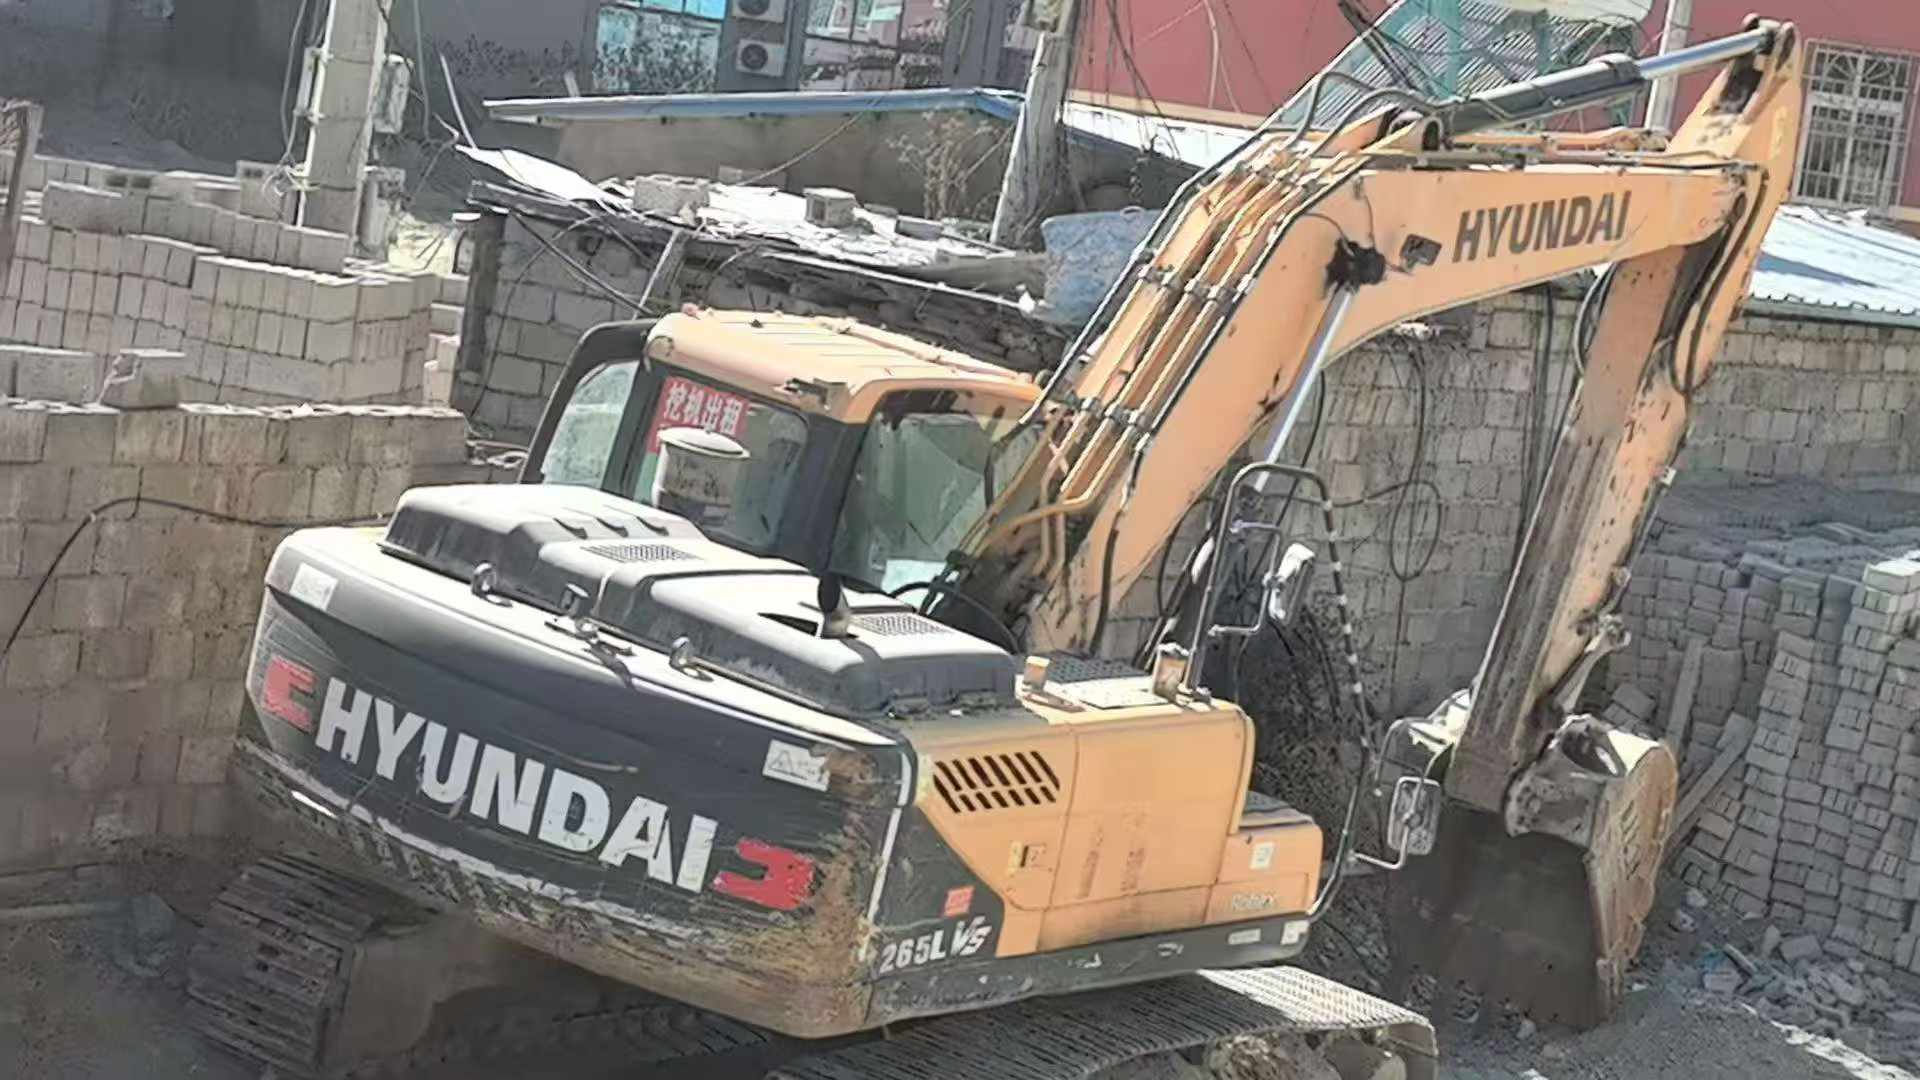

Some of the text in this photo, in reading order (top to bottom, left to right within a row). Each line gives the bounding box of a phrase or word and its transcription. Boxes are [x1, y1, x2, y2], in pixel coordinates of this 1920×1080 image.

[1453, 190, 1631, 263] HYUNDAI
[664, 382, 743, 434] 挖机出租
[315, 677, 718, 892] HYUNDAI
